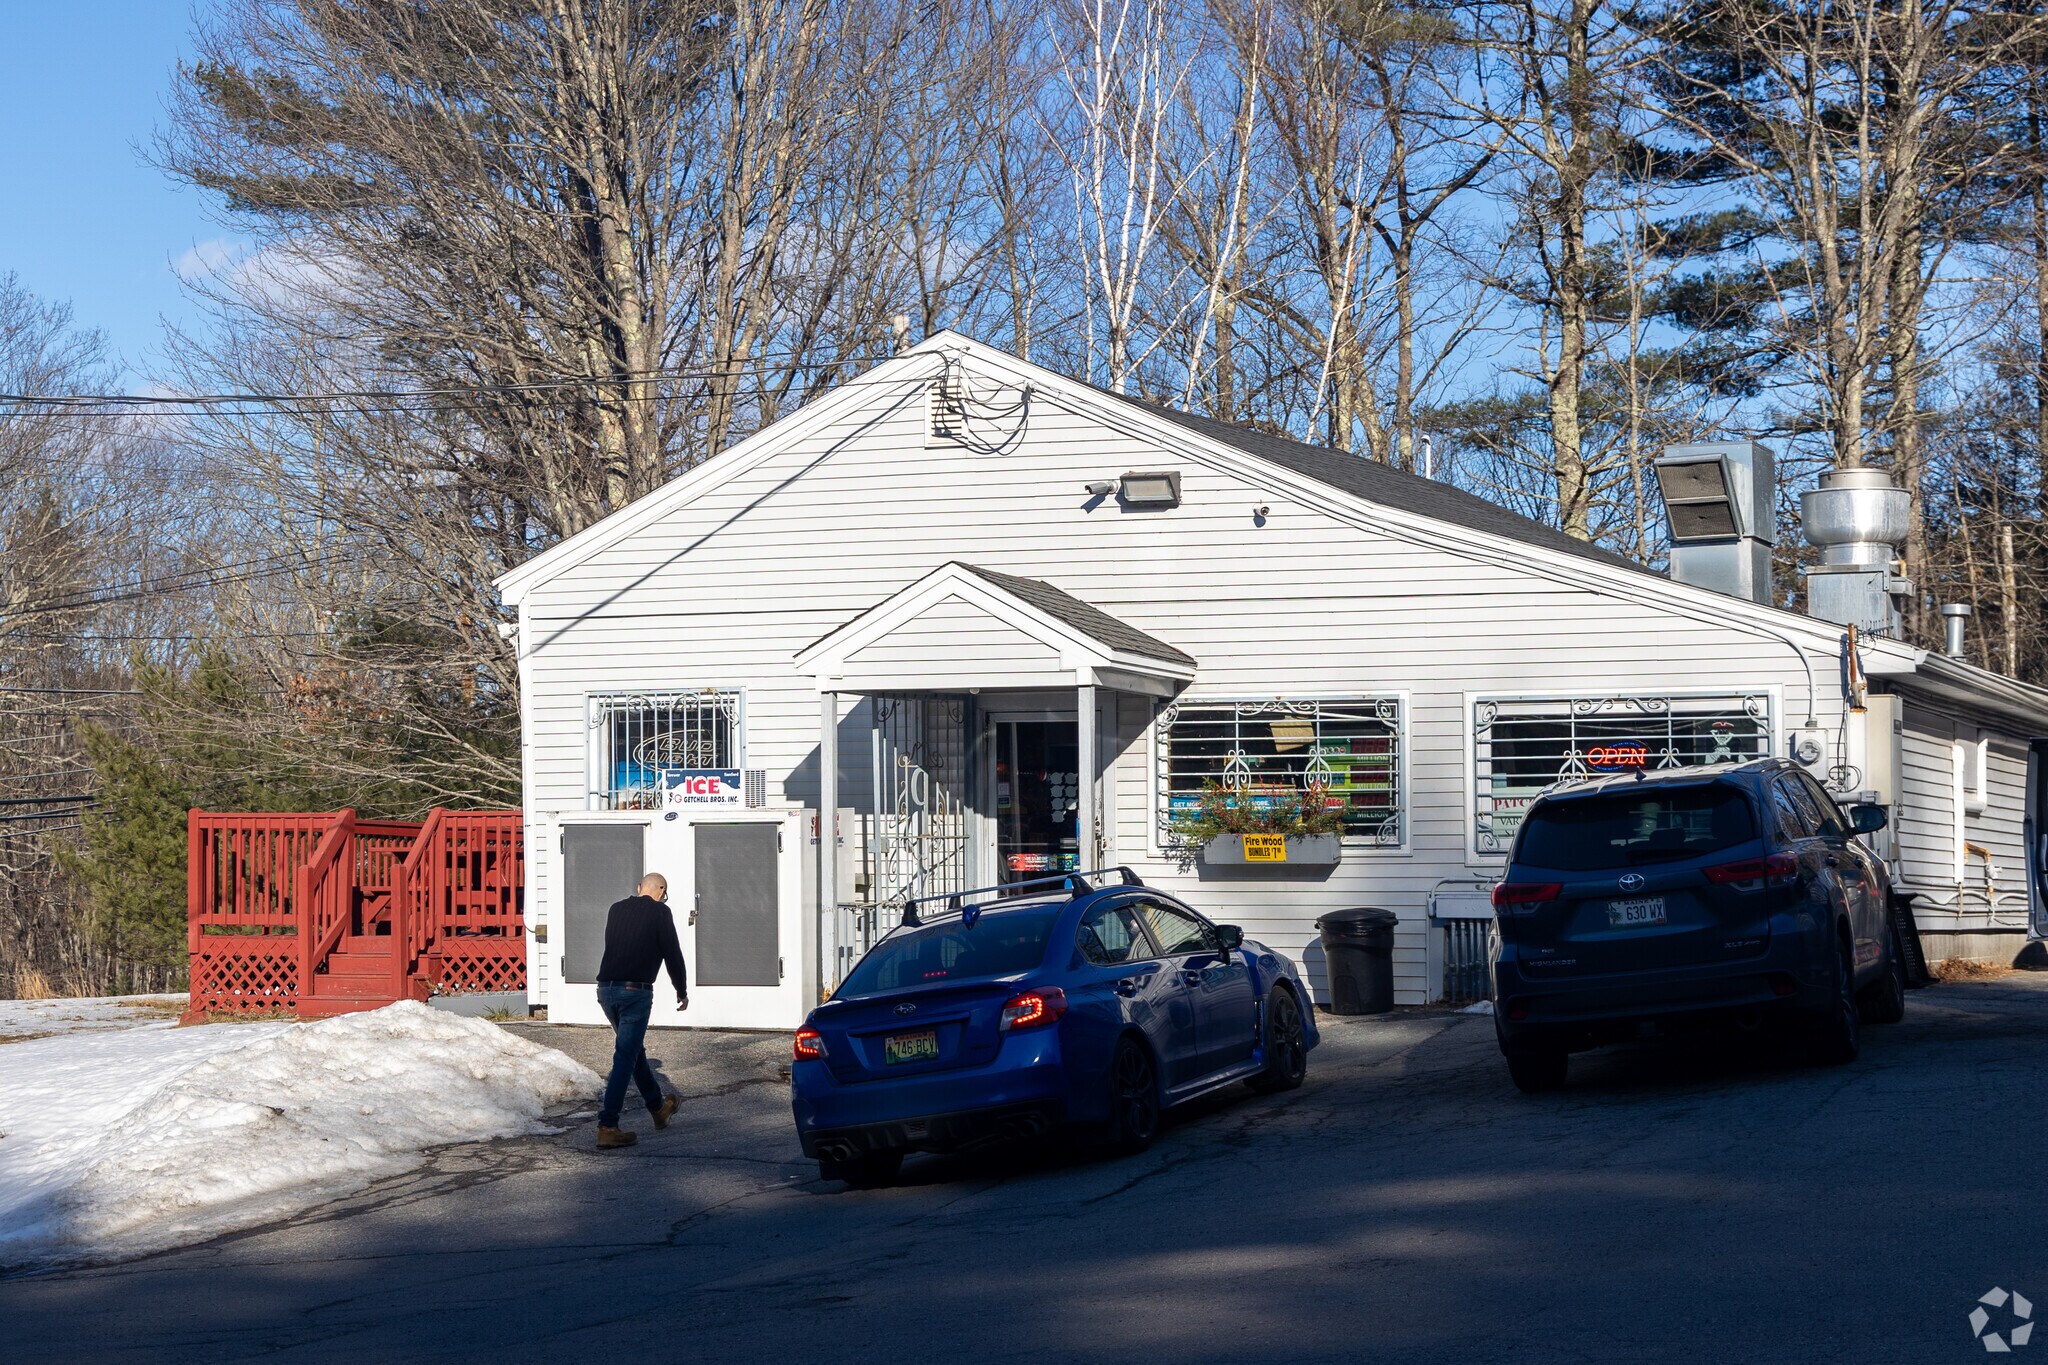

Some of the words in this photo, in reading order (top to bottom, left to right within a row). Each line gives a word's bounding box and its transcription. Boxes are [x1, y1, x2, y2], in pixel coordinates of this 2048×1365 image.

[659, 738, 716, 752] BUD
[644, 750, 718, 765] LIGHT
[1587, 747, 1647, 764] OPEN
[685, 776, 721, 794] ICE
[1494, 798, 1534, 811] PATC
[1245, 837, 1260, 846] Fire
[1261, 836, 1283, 846] Wood
[1248, 847, 1271, 857] BUNDLES
[1626, 905, 1646, 921] 630
[1649, 903, 1664, 919] WX
